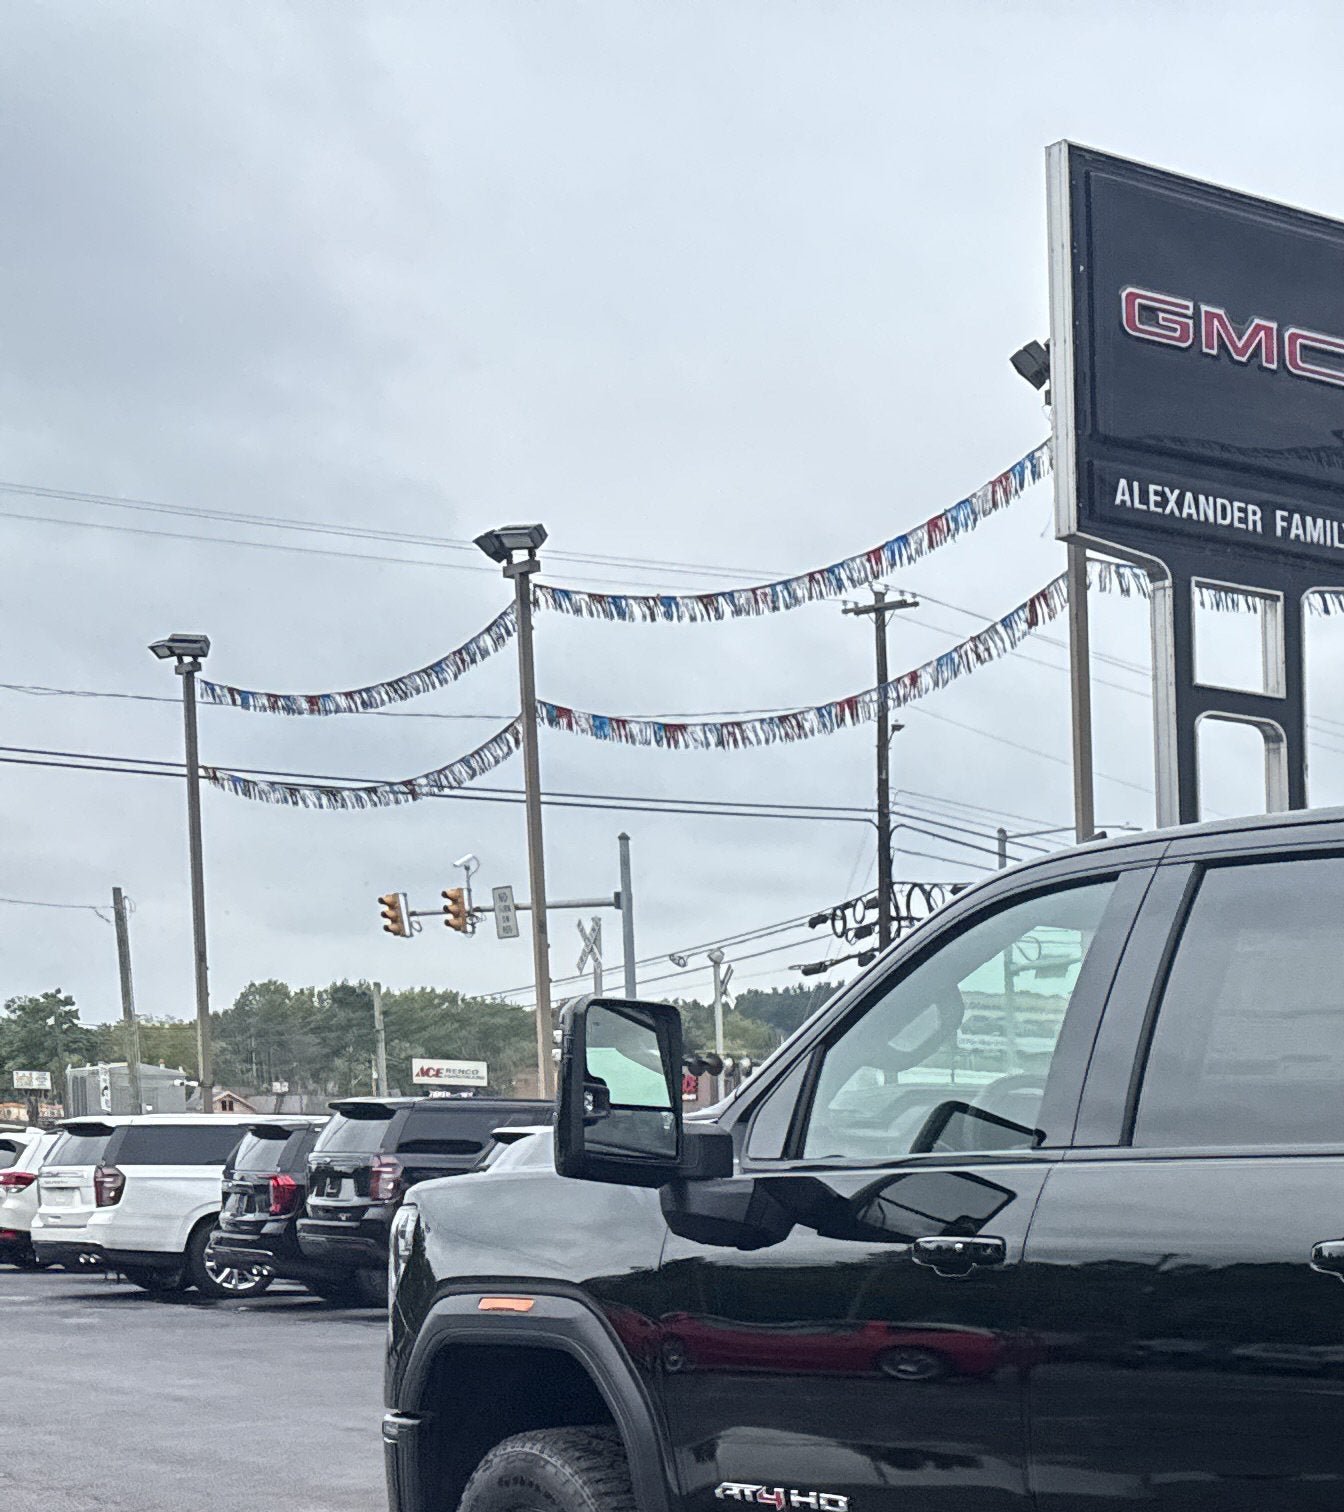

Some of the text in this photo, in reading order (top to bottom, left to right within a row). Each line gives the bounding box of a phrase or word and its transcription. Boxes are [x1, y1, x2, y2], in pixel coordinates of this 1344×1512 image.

[1115, 478, 1262, 534] ALEXANDER
[415, 1065, 444, 1079] ACE
[714, 1482, 849, 1512] AT4 HD
